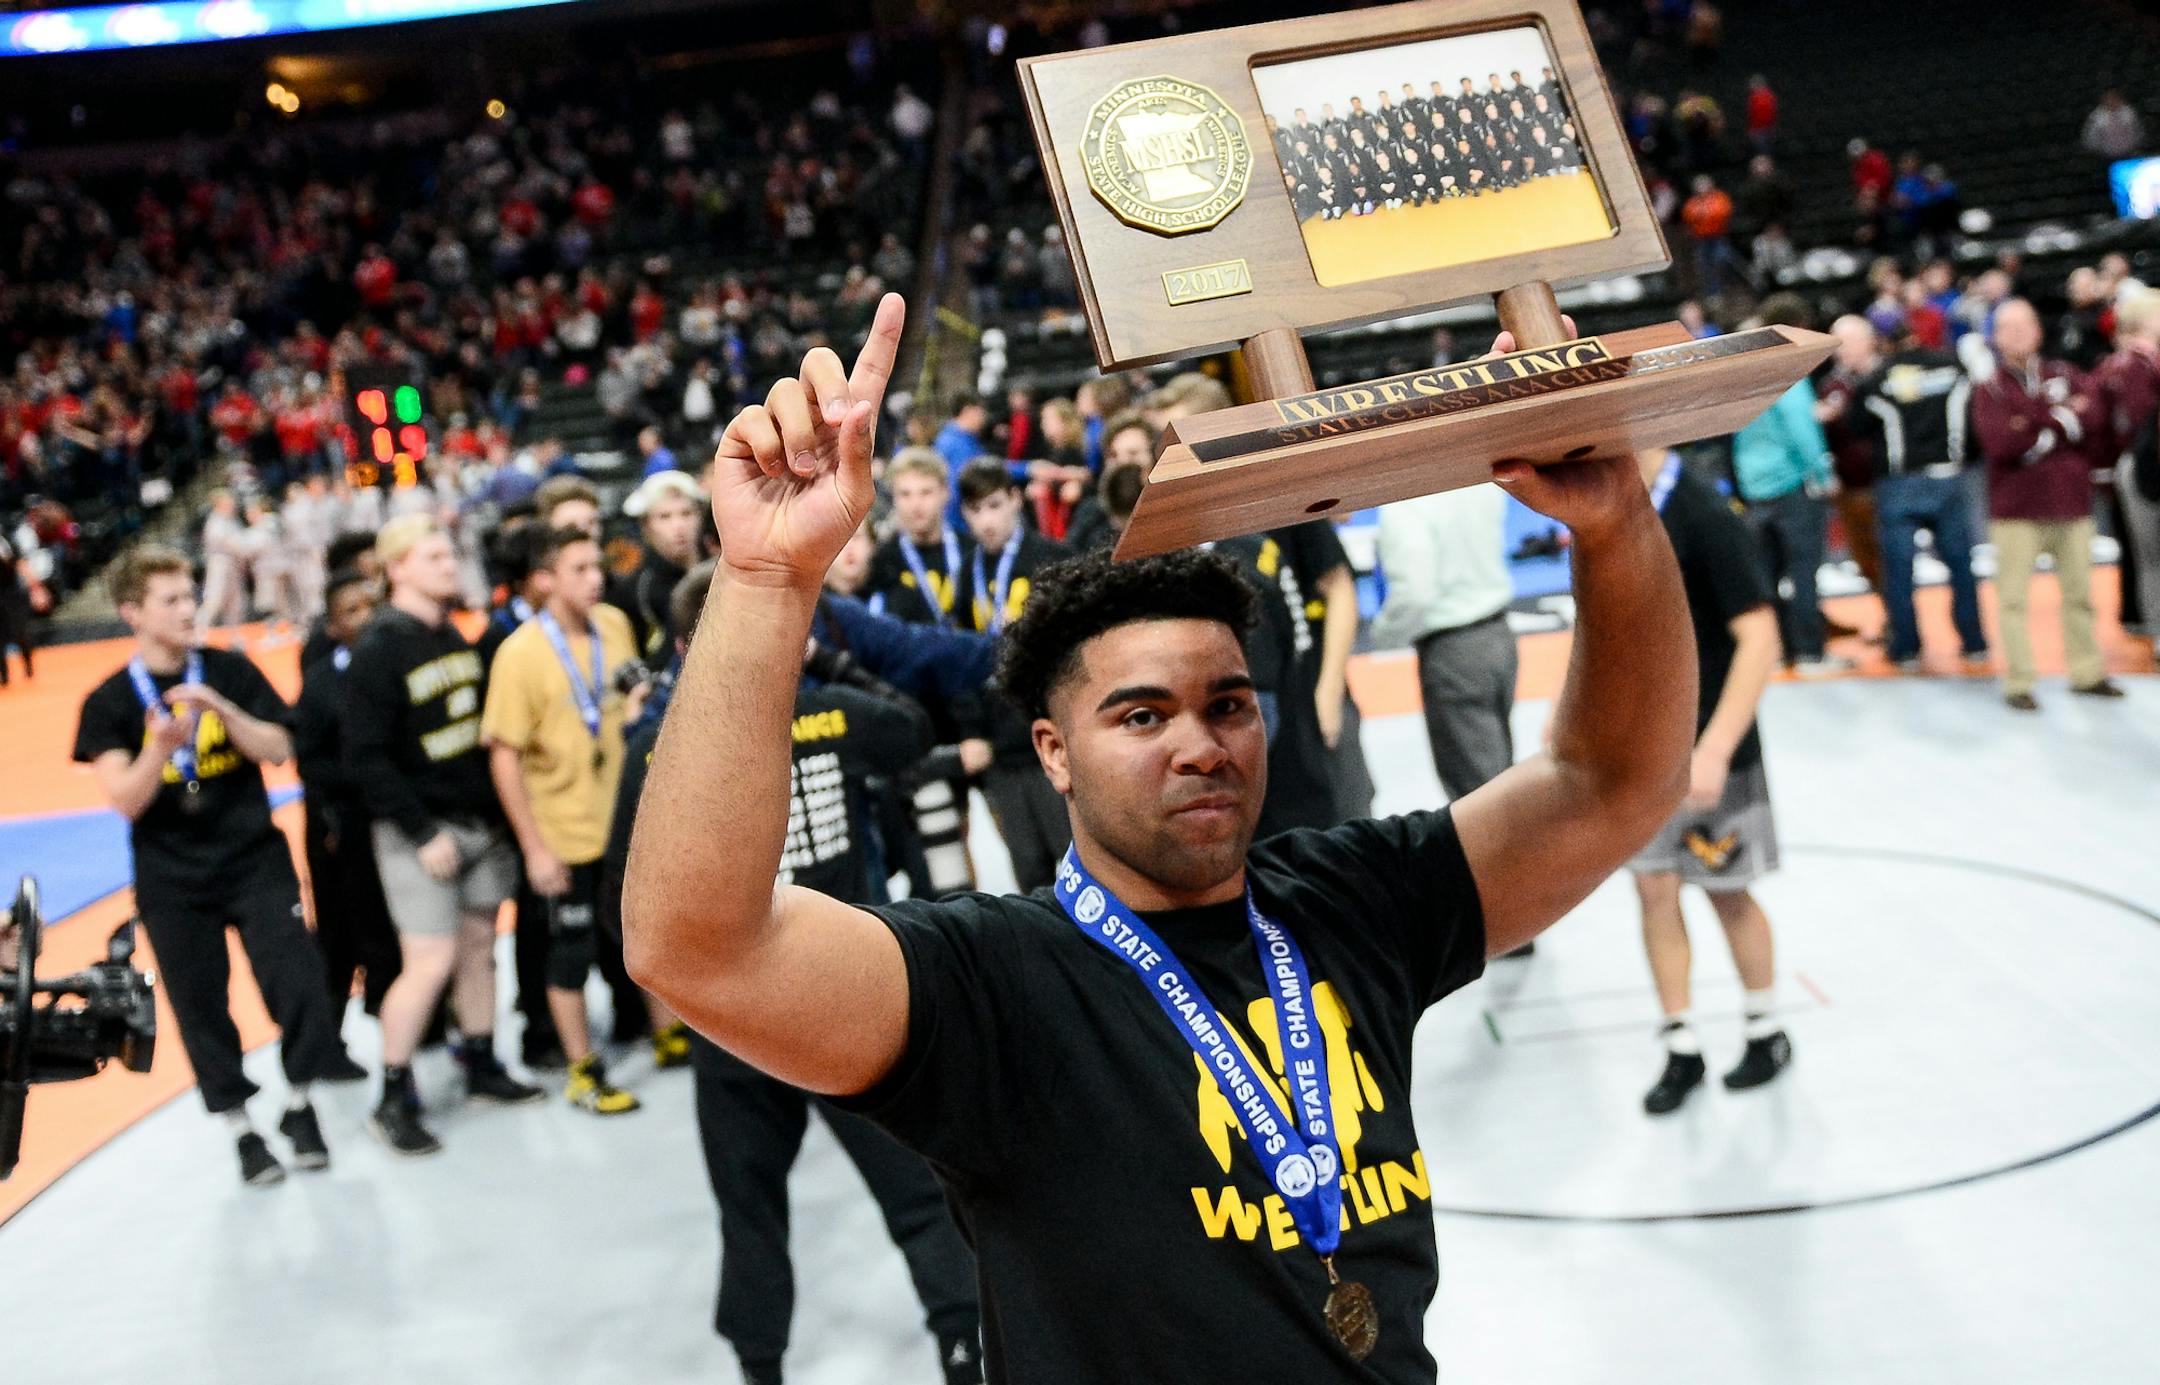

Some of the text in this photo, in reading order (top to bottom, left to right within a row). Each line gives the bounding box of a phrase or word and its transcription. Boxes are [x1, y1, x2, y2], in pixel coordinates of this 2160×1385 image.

[1095, 81, 1207, 122] MINNESOTA
[1089, 131, 1249, 226] STATE HIGH SCHOOL LEAGUE
[1118, 127, 1216, 175] MSHSL
[1171, 266, 1244, 297] 2017
[1277, 344, 1714, 442] STATE CLASS AAA CHAM
[1284, 342, 1608, 418] WRESTLING
[1101, 914, 1162, 972] STATE
[1157, 970, 1287, 1155] CHAMPIONSHIPS
[1295, 1057, 1328, 1137] STATE
